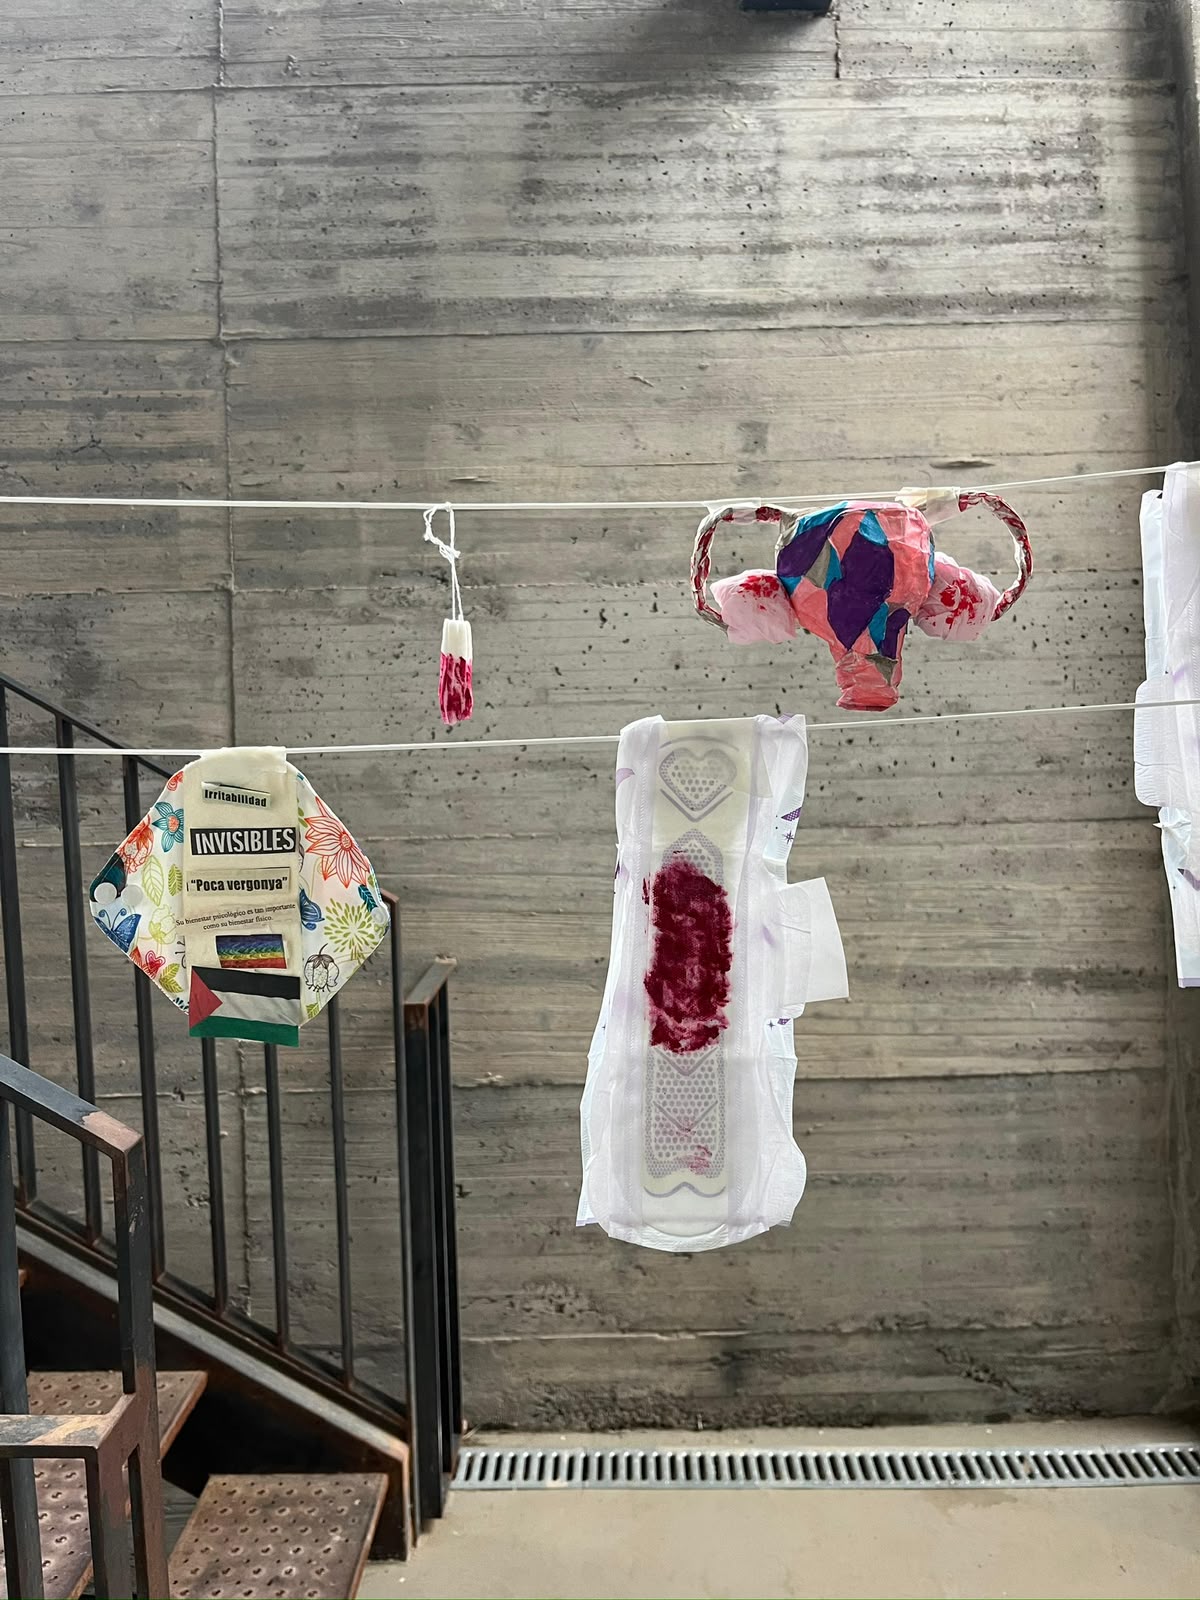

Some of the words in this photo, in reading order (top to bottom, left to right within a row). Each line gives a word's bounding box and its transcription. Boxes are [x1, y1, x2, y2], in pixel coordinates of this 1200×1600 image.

[204, 789, 267, 808] Irritabilidad
[195, 828, 295, 854] INVISIBLES
[190, 879, 224, 892] “Poca
[227, 876, 288, 892] vergonya”
[185, 915, 211, 925] bienestar
[213, 909, 246, 921] psicológico
[265, 903, 296, 912] importante
[228, 918, 254, 926] bienestar
